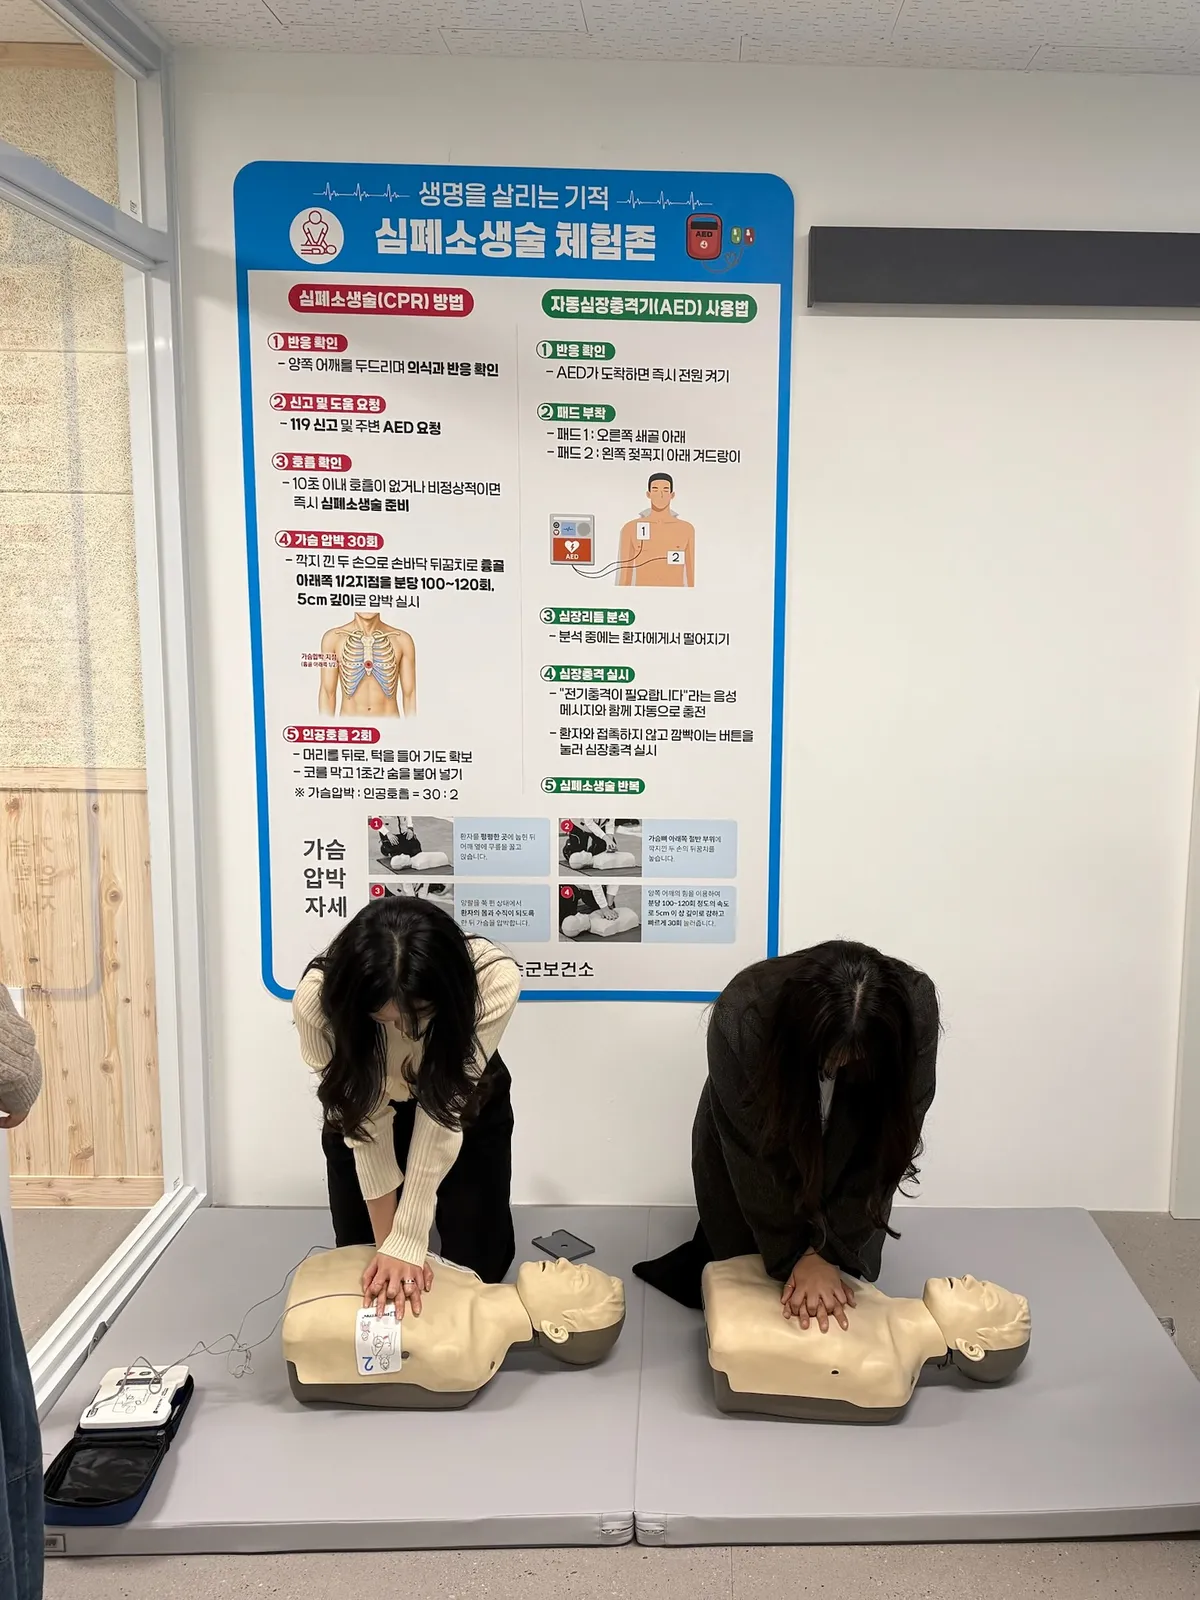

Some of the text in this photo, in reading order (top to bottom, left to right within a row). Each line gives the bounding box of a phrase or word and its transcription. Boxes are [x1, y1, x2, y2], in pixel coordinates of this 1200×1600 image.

[418, 181, 610, 211] 생명을 살리는 기적
[374, 217, 656, 262] 심폐소생술 체험존
[298, 289, 464, 312] 심폐소생술(CPR) 방법
[550, 294, 749, 318] 자동심장충격기(AED) 사용법
[287, 335, 338, 350] 반응 확인
[556, 343, 606, 358] 반응 확인
[288, 357, 499, 377] 양쪽 어깨를 두드리며 의식과 반응 확인
[556, 366, 730, 384] AED가 도착하면 즉시 전원 켜기
[290, 396, 381, 412] 신고 및 도움 요청
[557, 406, 606, 420] 패드 부착
[290, 418, 441, 435] 119 신고 및 주변 AED 요청
[557, 427, 686, 444] 패드 오른쪽 쇄골 아래
[292, 456, 342, 470] 호흡 확인
[557, 446, 741, 464] 패드 왼쪽 젖꼭지 아래 겨드랑이
[292, 477, 501, 496] 10초 이내 호흡이 없거나 비정상적이면
[293, 496, 410, 512] 즉시 심폐소생술 준비
[641, 526, 645, 536] 1
[294, 533, 378, 548] 가슴 압박 30회
[295, 554, 505, 573] 깍지 낀 두 손으로 손바닥 뒤꿈치로 흉골
[672, 552, 680, 562] 2
[296, 574, 333, 588] 아래쪽
[335, 575, 392, 590] 1/2지점을
[394, 577, 419, 590] 분당
[297, 592, 421, 609] 5cm 깊이로 압박 실시
[559, 610, 630, 624] 심장리듬 분석
[559, 630, 730, 646] 분석 중에는 환자에게서 떨어지기
[559, 668, 629, 681] 심장충격 실시
[559, 687, 623, 701] "전기충격이
[713, 689, 737, 703] 음성
[560, 704, 706, 718] 메시지와 함께 자동으로 충전
[302, 728, 373, 742] 인공호흡 2회
[560, 727, 754, 743] 환자와 접촉하지 않고 깜빡이는 버튼을
[303, 749, 339, 762] 머리를
[371, 750, 395, 763] 턱을
[397, 750, 421, 763] 들어
[423, 750, 447, 764] 기도
[449, 750, 473, 764] 확보
[560, 743, 657, 757] 눌러 심장충격 실시
[303, 766, 463, 781] 코를 막고 1초간 숨을 불어 넣기
[308, 787, 355, 799] 가슴압박
[363, 788, 410, 800] 인공호흡
[560, 780, 640, 793] 심폐소생술 반복
[374, 820, 379, 828] 1
[564, 822, 570, 830] 2
[303, 838, 347, 861] 가슴
[303, 866, 347, 889] 압박
[374, 887, 381, 895] 3
[564, 888, 570, 896] 4
[304, 896, 347, 918] 자세
[517, 961, 595, 978] 군보건소
[362, 1356, 374, 1372] 2
